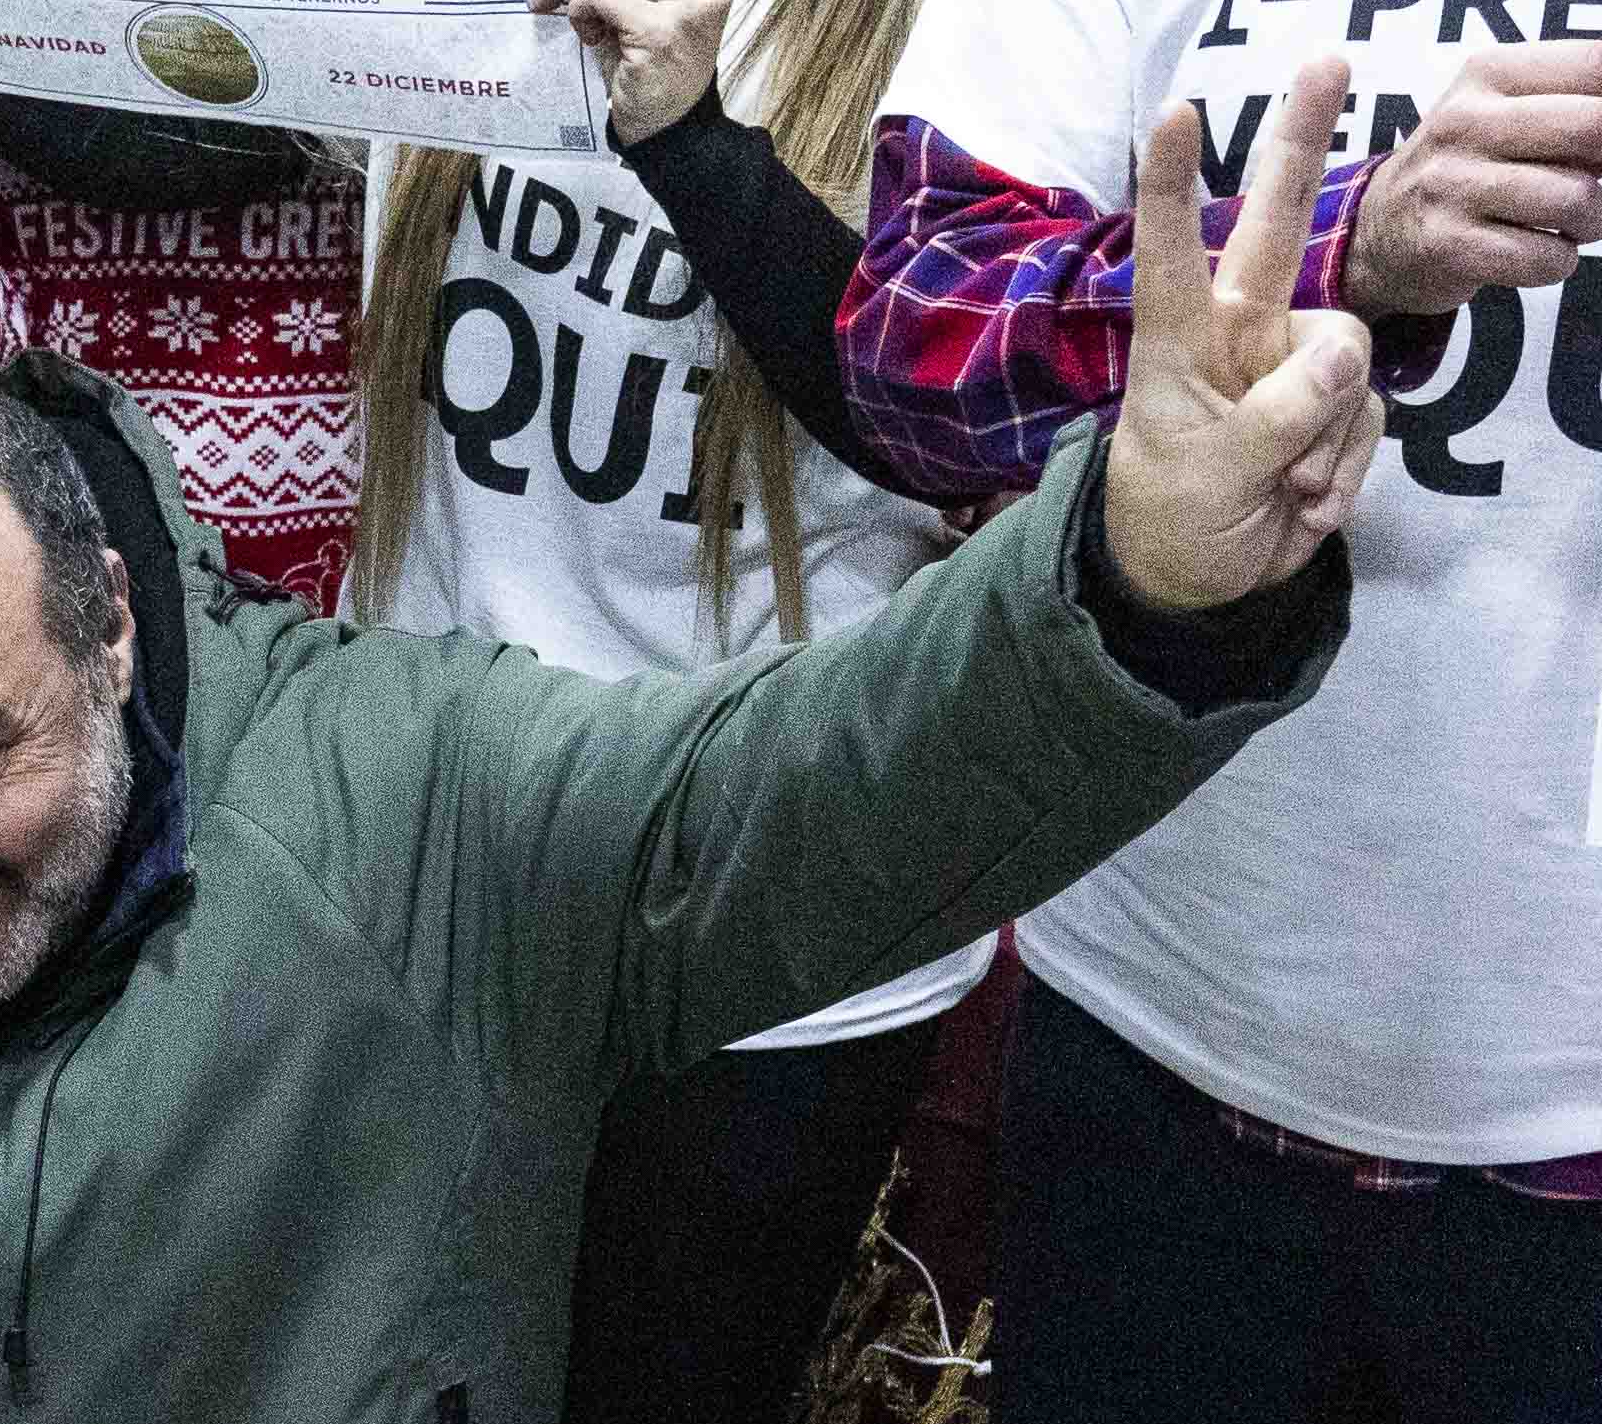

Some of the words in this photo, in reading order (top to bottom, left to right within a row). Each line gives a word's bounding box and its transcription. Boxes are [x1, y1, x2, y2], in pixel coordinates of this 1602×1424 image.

[328, 69, 357, 86] 22
[366, 72, 512, 98] DICIEMBRE
[11, 201, 220, 259] FESTIVE
[239, 201, 362, 260] CRE
[466, 164, 702, 322] NDID
